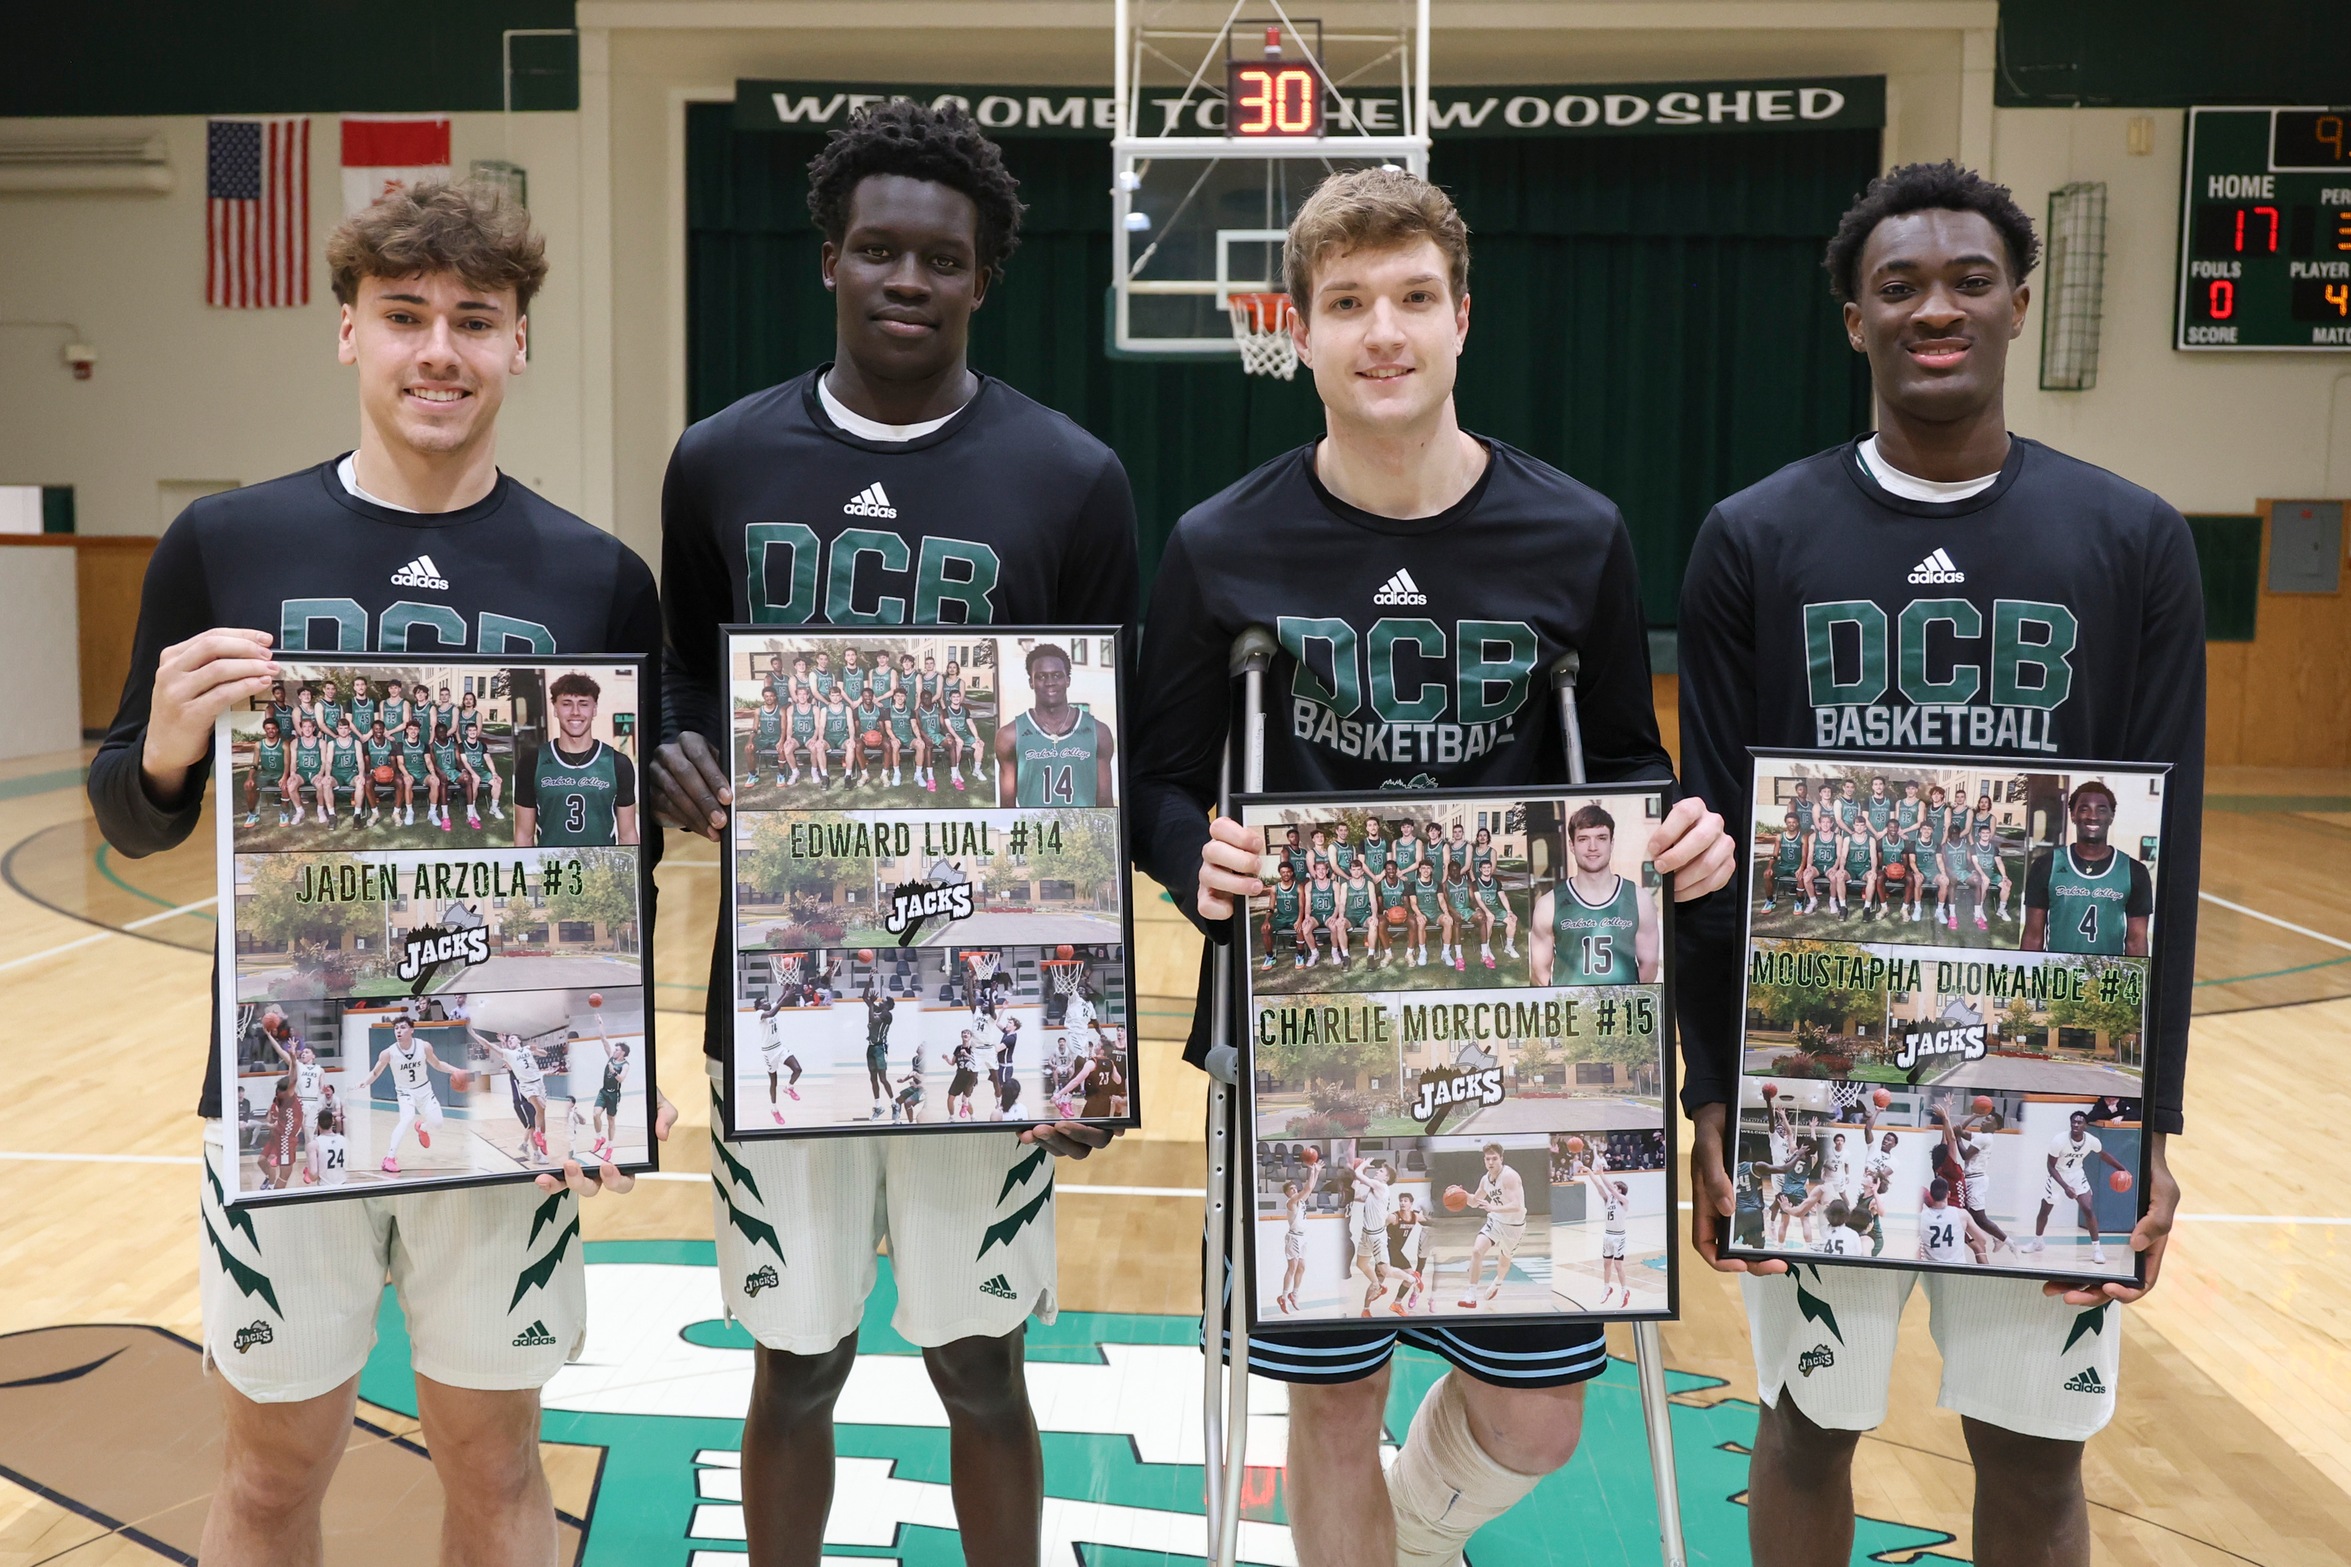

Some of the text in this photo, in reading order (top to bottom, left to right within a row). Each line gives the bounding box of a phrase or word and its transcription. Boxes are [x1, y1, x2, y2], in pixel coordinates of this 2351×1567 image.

[1239, 70, 1313, 133] 30
[1424, 88, 1845, 130] WOODSHED
[2208, 175, 2275, 199] HOME
[2235, 207, 2279, 252] 17
[2191, 261, 2242, 279] FOULS
[2290, 261, 2350, 279] PLAYER
[2209, 280, 2234, 319] 0
[2325, 284, 2348, 317] 4
[2187, 326, 2239, 344] SCORE
[843, 502, 897, 519] adidas
[391, 572, 449, 591] adidas
[745, 522, 1000, 624] DCB
[1907, 569, 1965, 584] adidas
[1373, 590, 1428, 606] adidas
[1803, 598, 2078, 711] DCB
[1276, 616, 1539, 724] DCB
[1816, 706, 2058, 752] BASKETBALL
[1060, 747, 1090, 760] College
[541, 776, 610, 790] Dakota College
[1043, 765, 1074, 804] 14
[565, 794, 585, 832] 3
[790, 820, 1063, 859] EDWARD LUAL #14
[295, 858, 584, 903] JADEN ARZOLA #3
[2055, 885, 2124, 901] Dakota College
[887, 885, 973, 932] JACKS
[1560, 916, 1633, 930] Dakota College
[2077, 904, 2098, 943] 4
[400, 927, 489, 980] JACKS
[1582, 935, 1613, 975] 15
[1752, 951, 2140, 1005] MOUSTAPHA DIOMANDE #4
[1259, 998, 1655, 1046] CHARLIE MORCOMBE #15
[1897, 1025, 1986, 1068] JACKS
[400, 1061, 421, 1071] JACKS
[409, 1069, 416, 1082] 3
[1099, 1071, 1110, 1085] 23
[1414, 1068, 1502, 1120] JACKS
[327, 1148, 344, 1169] 24
[1794, 1160, 1806, 1174] 6
[1833, 1164, 1838, 1172] 5
[2066, 1158, 2075, 1169] 4
[1607, 1211, 1614, 1221] 15
[1930, 1225, 1954, 1248] 24
[1824, 1239, 1844, 1254] 45
[746, 1272, 778, 1291] JACKS
[979, 1283, 1017, 1300] adidas
[235, 1331, 271, 1348] JACKS
[512, 1335, 556, 1347] adidas
[1800, 1352, 1834, 1371] JACKS
[2063, 1381, 2106, 1394] adidas
